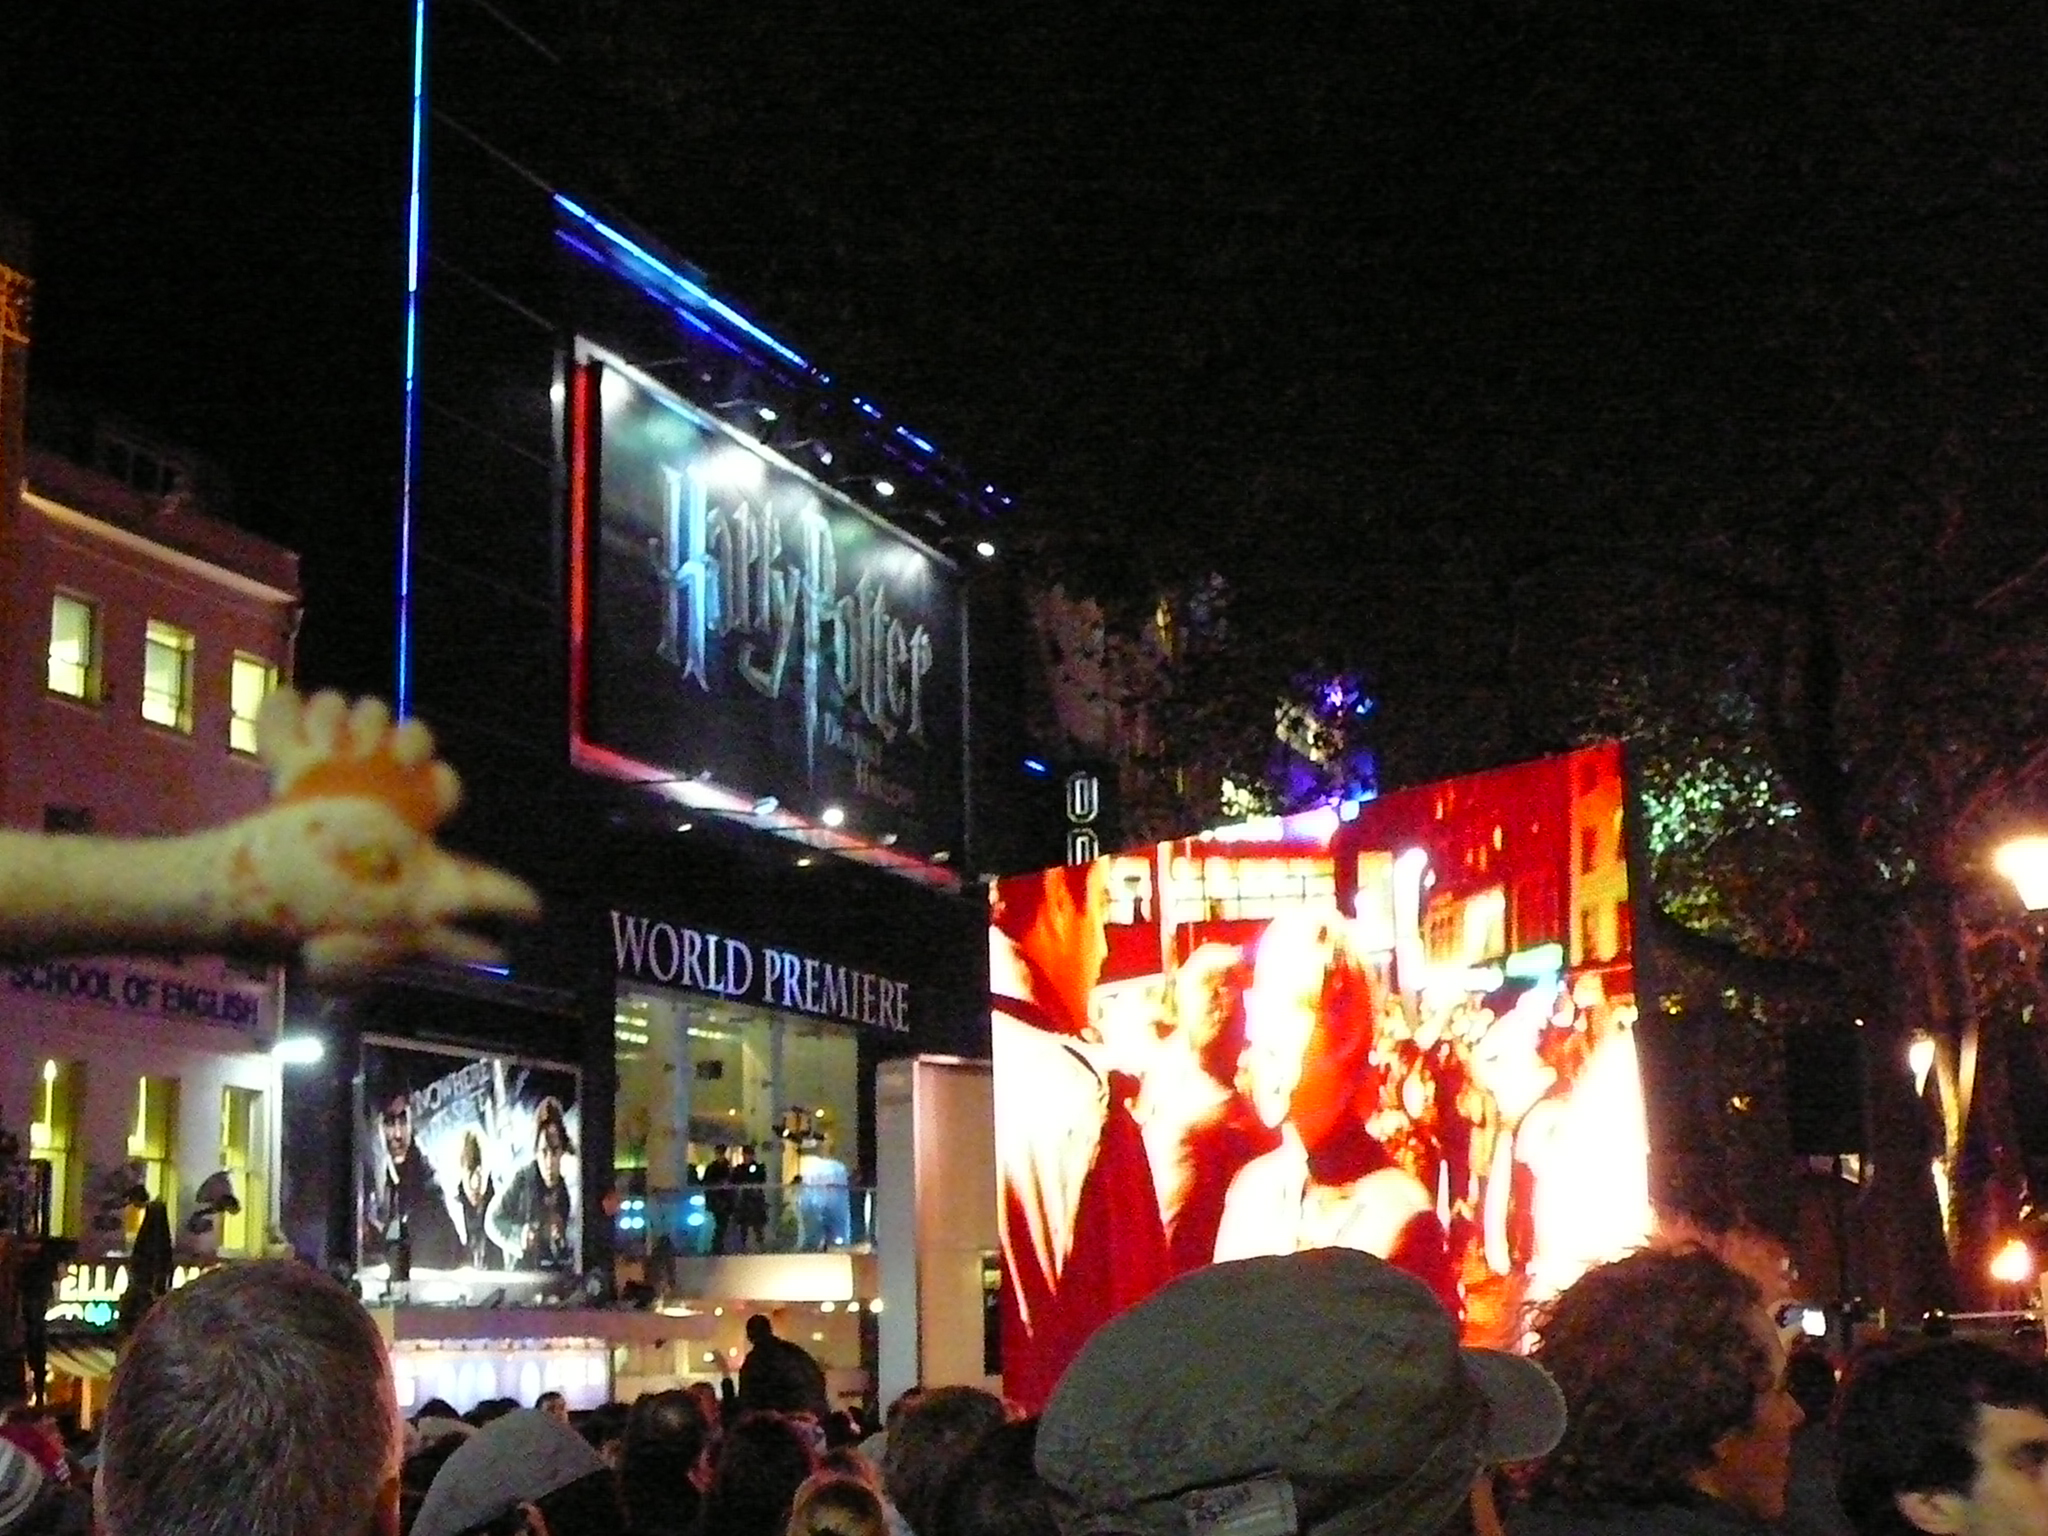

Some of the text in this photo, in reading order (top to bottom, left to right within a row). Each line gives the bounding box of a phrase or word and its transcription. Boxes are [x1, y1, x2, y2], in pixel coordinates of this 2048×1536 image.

[9, 962, 259, 1027] SCHOOL OF ENGLISH
[610, 909, 911, 1034] WORLD PREMIERE
